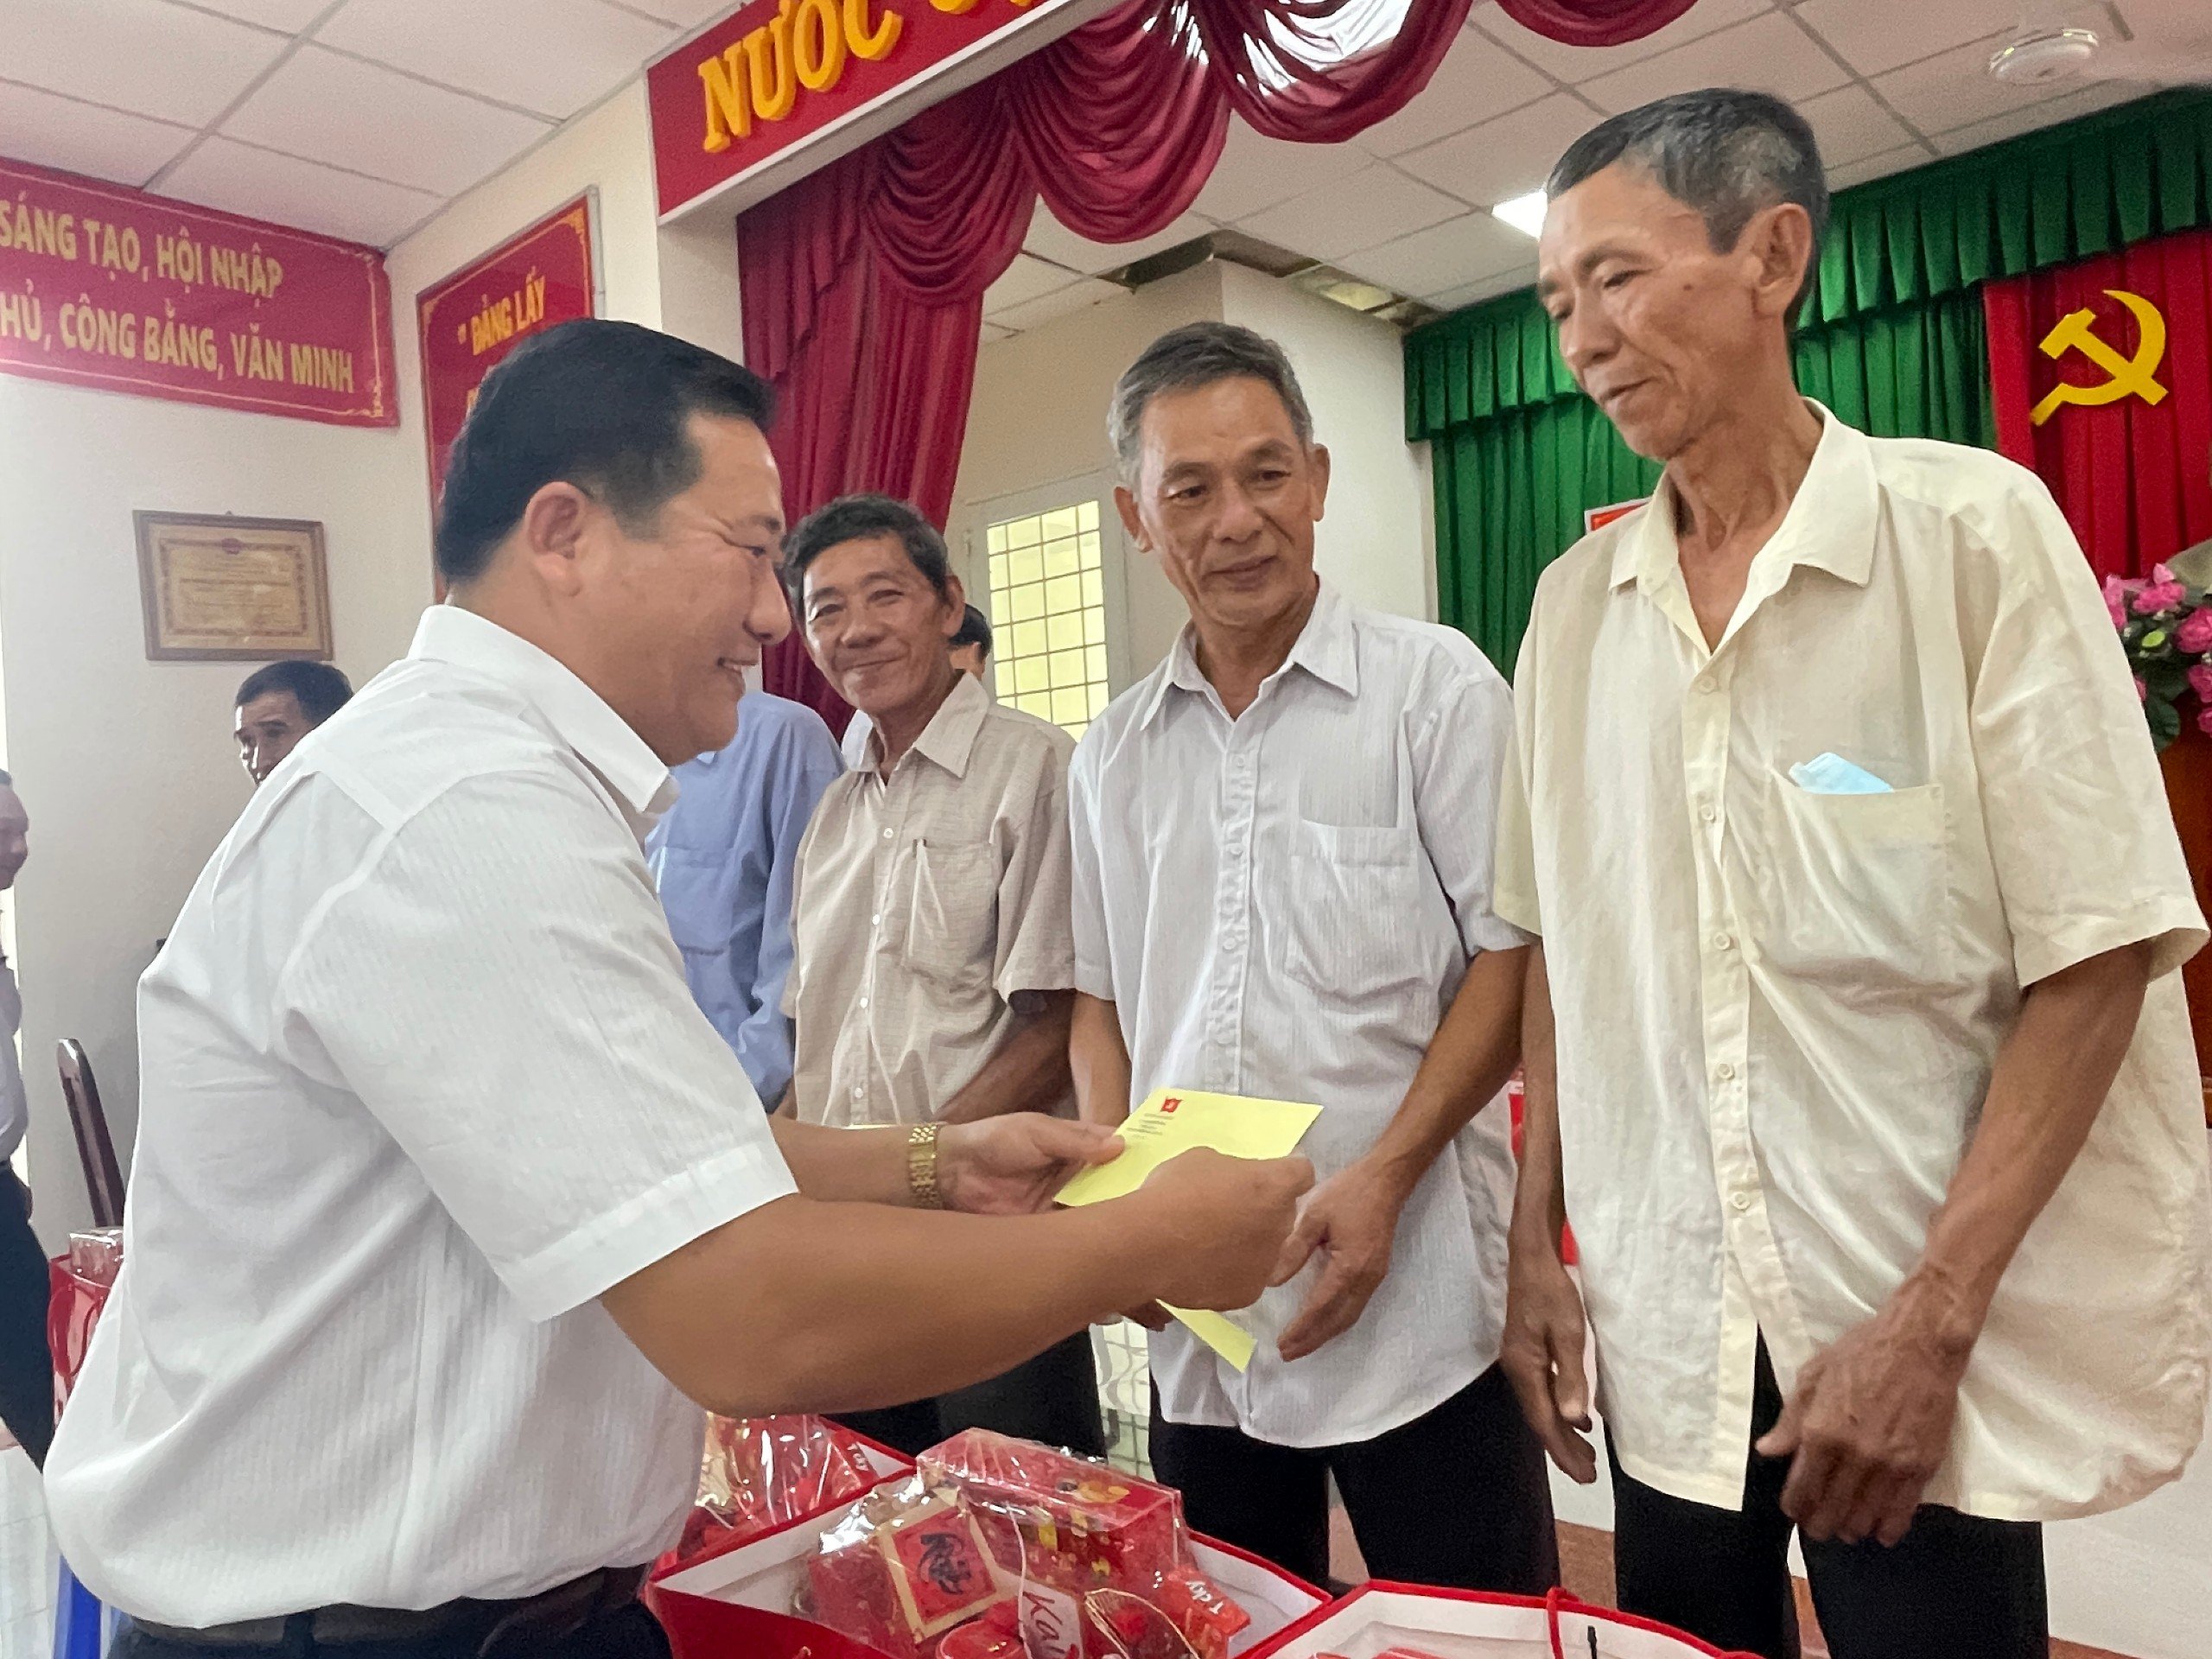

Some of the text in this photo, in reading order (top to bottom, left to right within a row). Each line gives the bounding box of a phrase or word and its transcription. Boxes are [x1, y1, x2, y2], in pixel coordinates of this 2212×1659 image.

[0, 191, 283, 308] SÁNG TẠO, HỘI NHẬP
[60, 293, 137, 360] CÔNG
[144, 298, 223, 380] BẰNG,
[230, 322, 284, 382] VĂN
[290, 343, 354, 393] MINH
